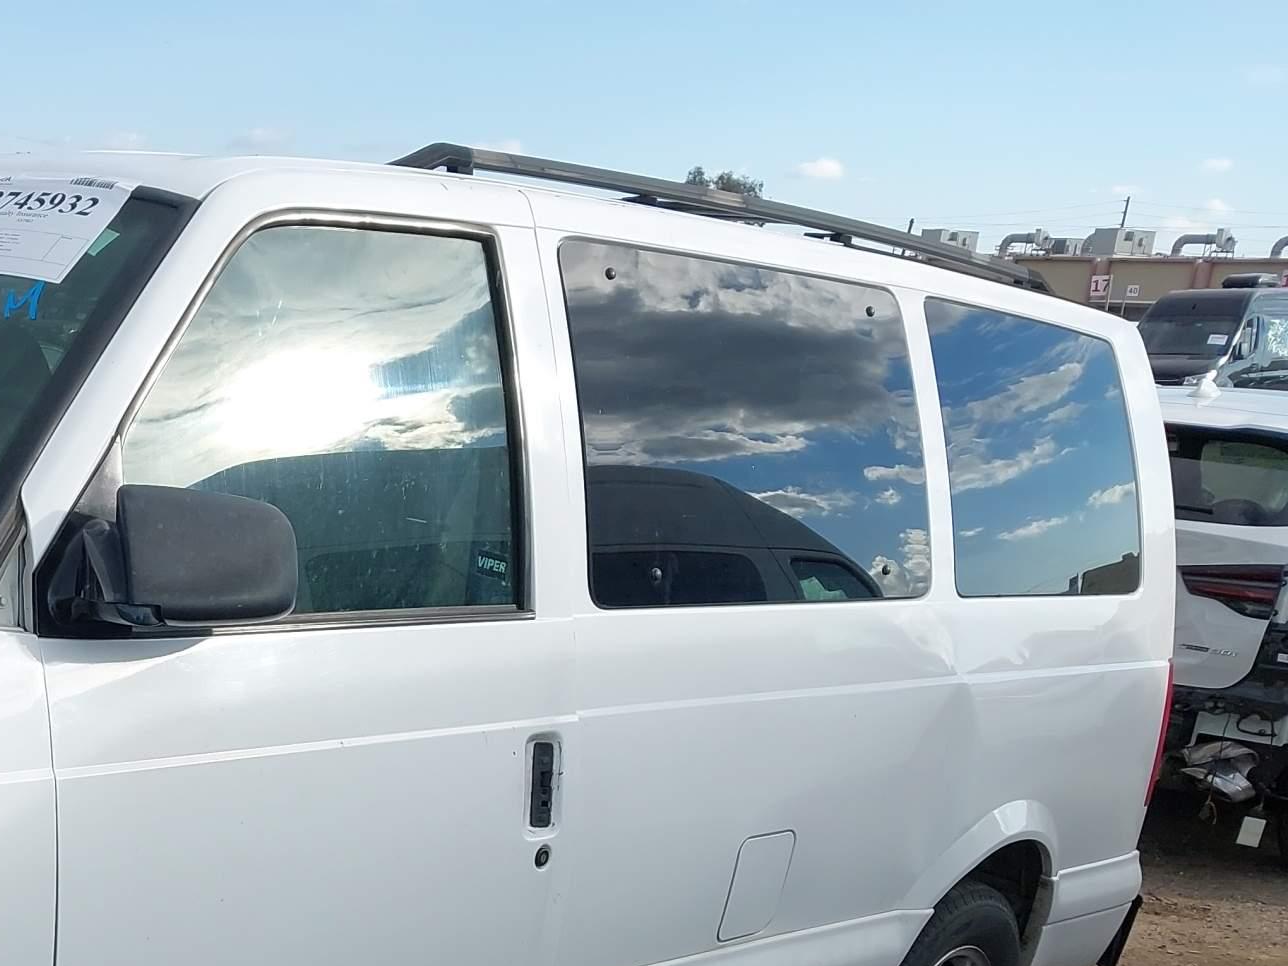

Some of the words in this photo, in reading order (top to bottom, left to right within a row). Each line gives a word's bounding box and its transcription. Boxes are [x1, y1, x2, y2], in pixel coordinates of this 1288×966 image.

[15, 211, 49, 219] Insurance
[1092, 279, 1110, 292] 17
[1128, 287, 1138, 295] 40
[478, 555, 507, 573] VIPER
